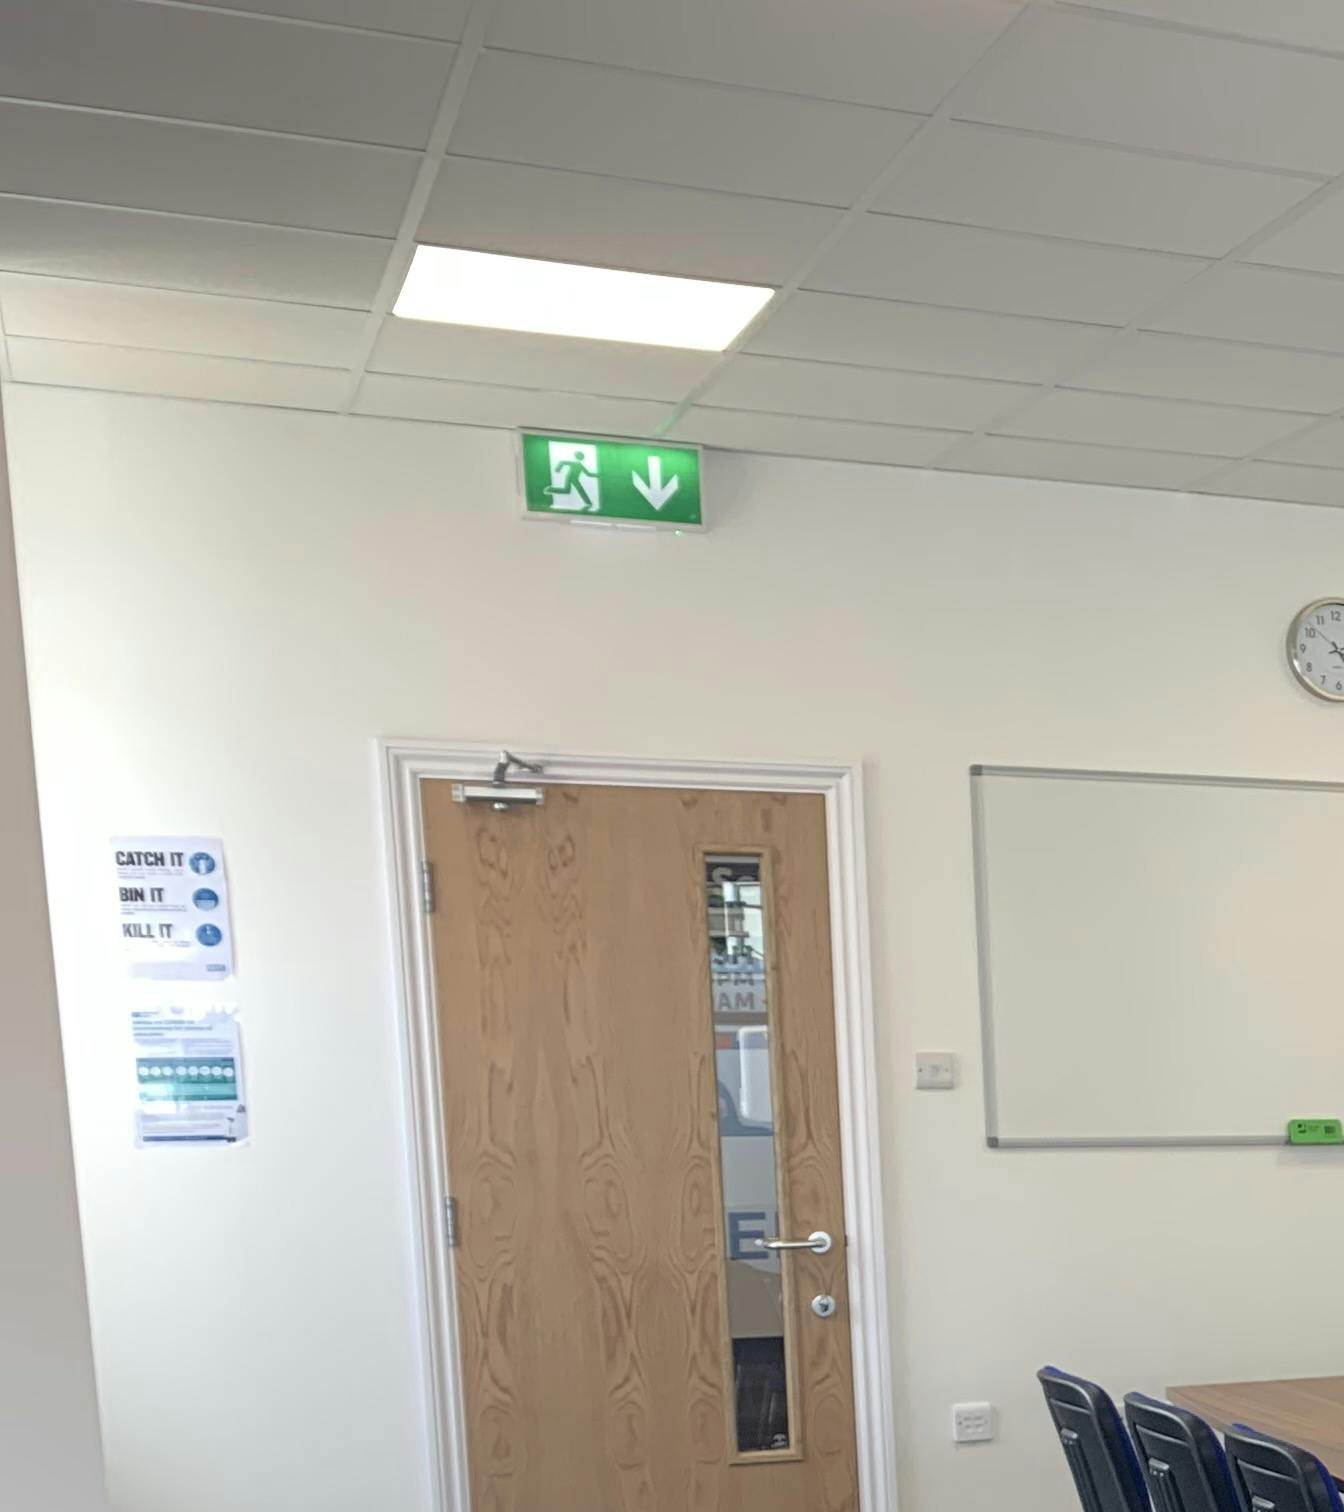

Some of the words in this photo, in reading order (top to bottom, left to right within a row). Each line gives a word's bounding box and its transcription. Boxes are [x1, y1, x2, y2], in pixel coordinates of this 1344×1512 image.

[1316, 616, 1325, 625] 11
[1331, 611, 1341, 622] 12
[1305, 628, 1316, 638] 10
[1300, 644, 1306, 653] 9
[1306, 663, 1312, 672] 8
[1320, 675, 1326, 684] 7
[1336, 681, 1342, 690] 6
[115, 851, 165, 866] CATCH
[170, 852, 184, 867] IT
[119, 887, 145, 902] BIN
[150, 888, 164, 902] IT
[122, 923, 155, 939] KILL
[159, 923, 173, 938] IT
[718, 992, 755, 1010] AM
